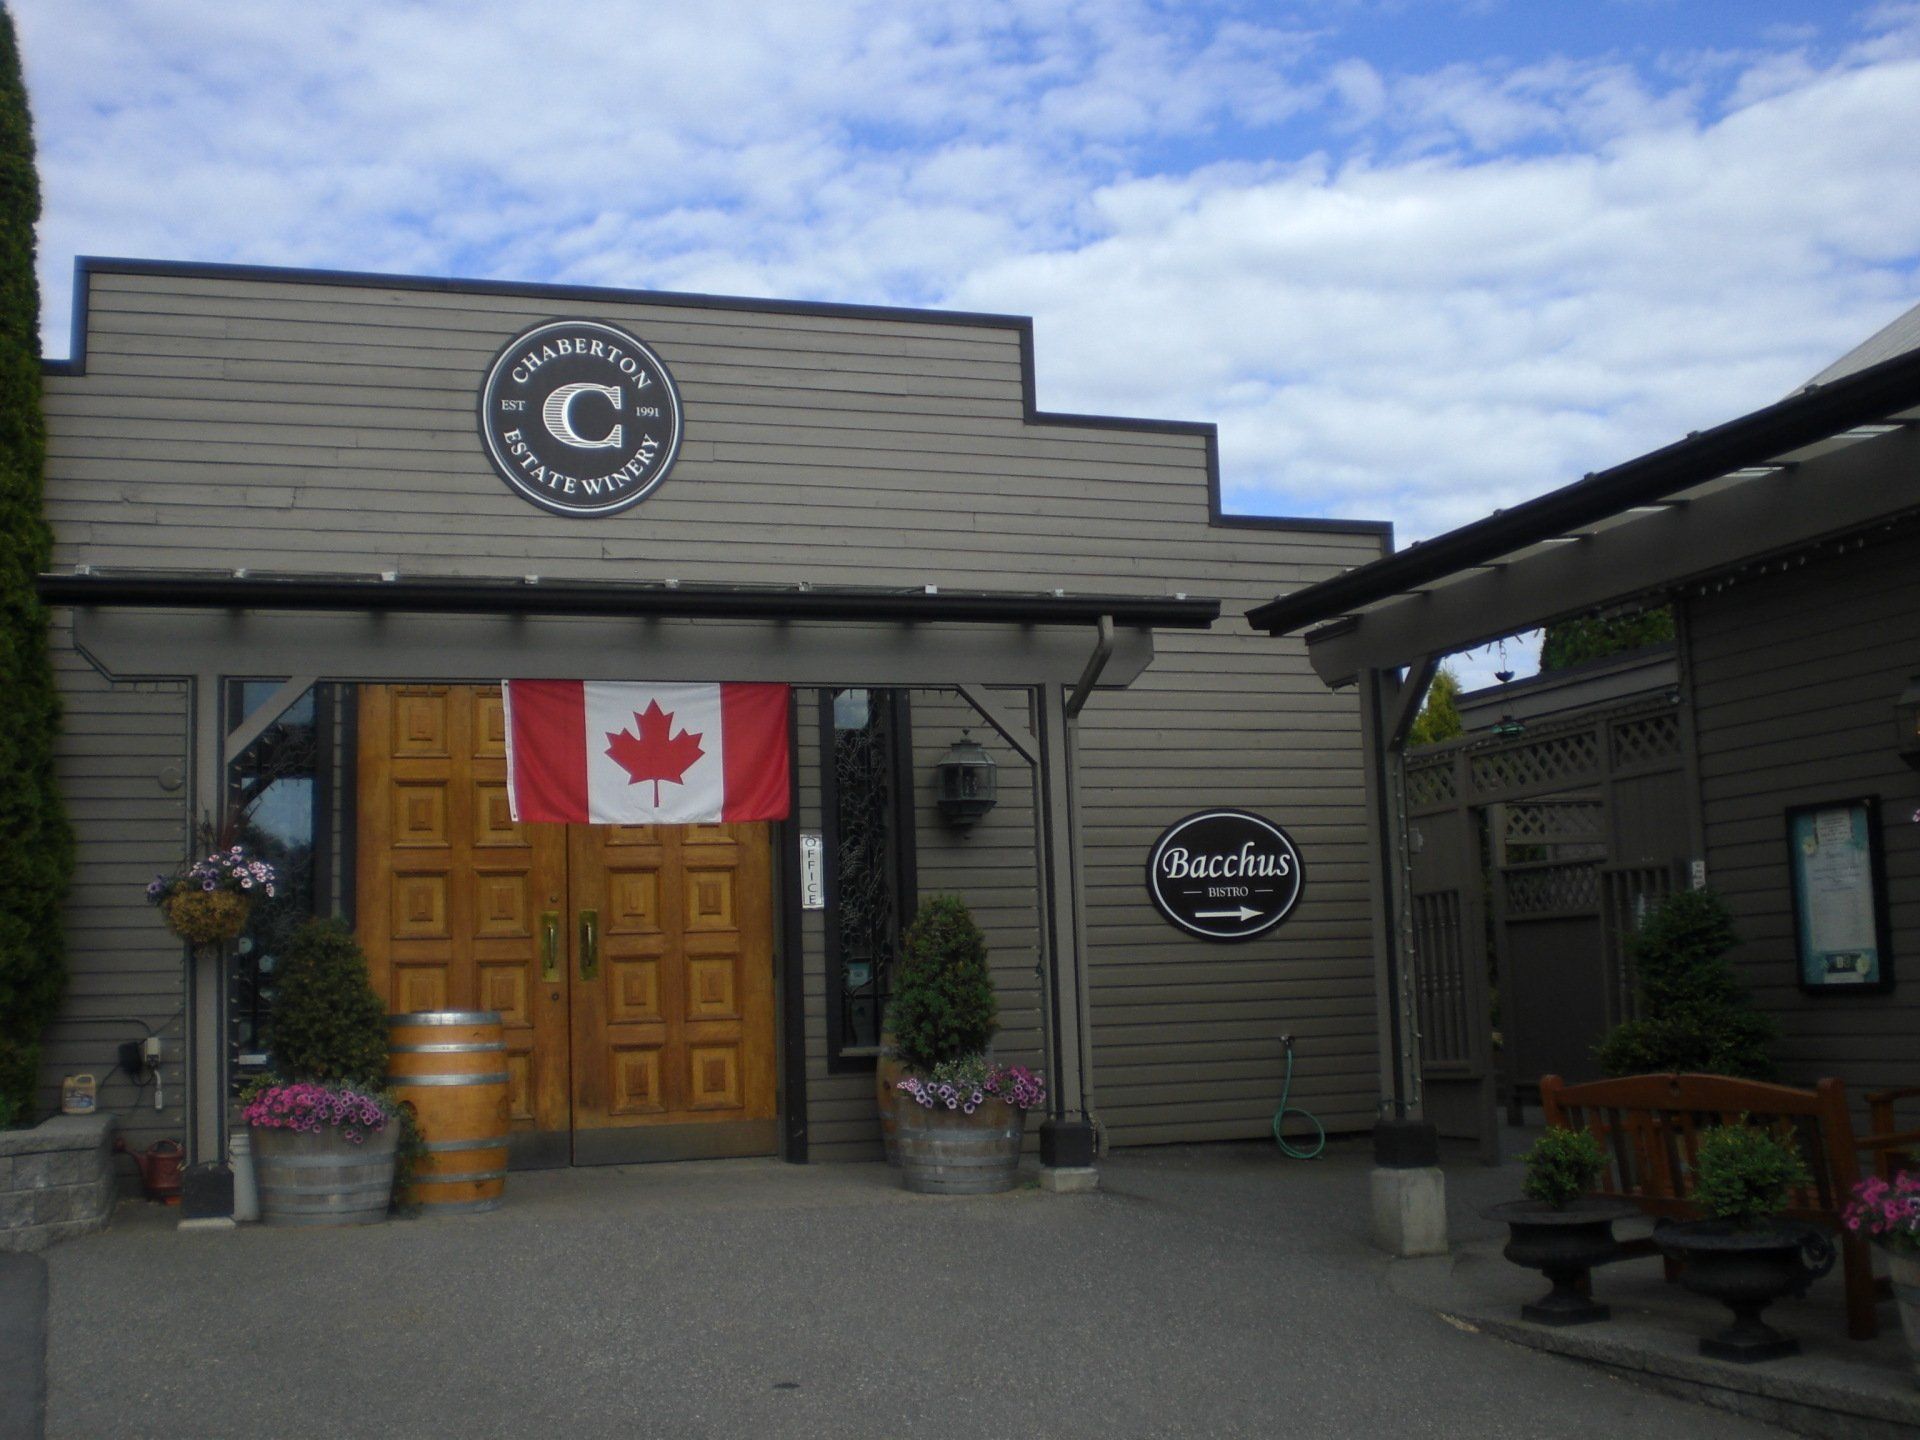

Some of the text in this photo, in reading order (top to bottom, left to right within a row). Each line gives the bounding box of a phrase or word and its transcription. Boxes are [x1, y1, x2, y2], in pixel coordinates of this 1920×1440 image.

[512, 338, 652, 389] CHABERTON
[501, 400, 526, 411] EST
[542, 382, 622, 448] C
[635, 406, 660, 417] 1991
[503, 428, 660, 495] ESTATE WINERY
[805, 837, 817, 904] OFFICE
[1162, 841, 1291, 879] Bacchus
[1208, 887, 1249, 898] BISTRO
